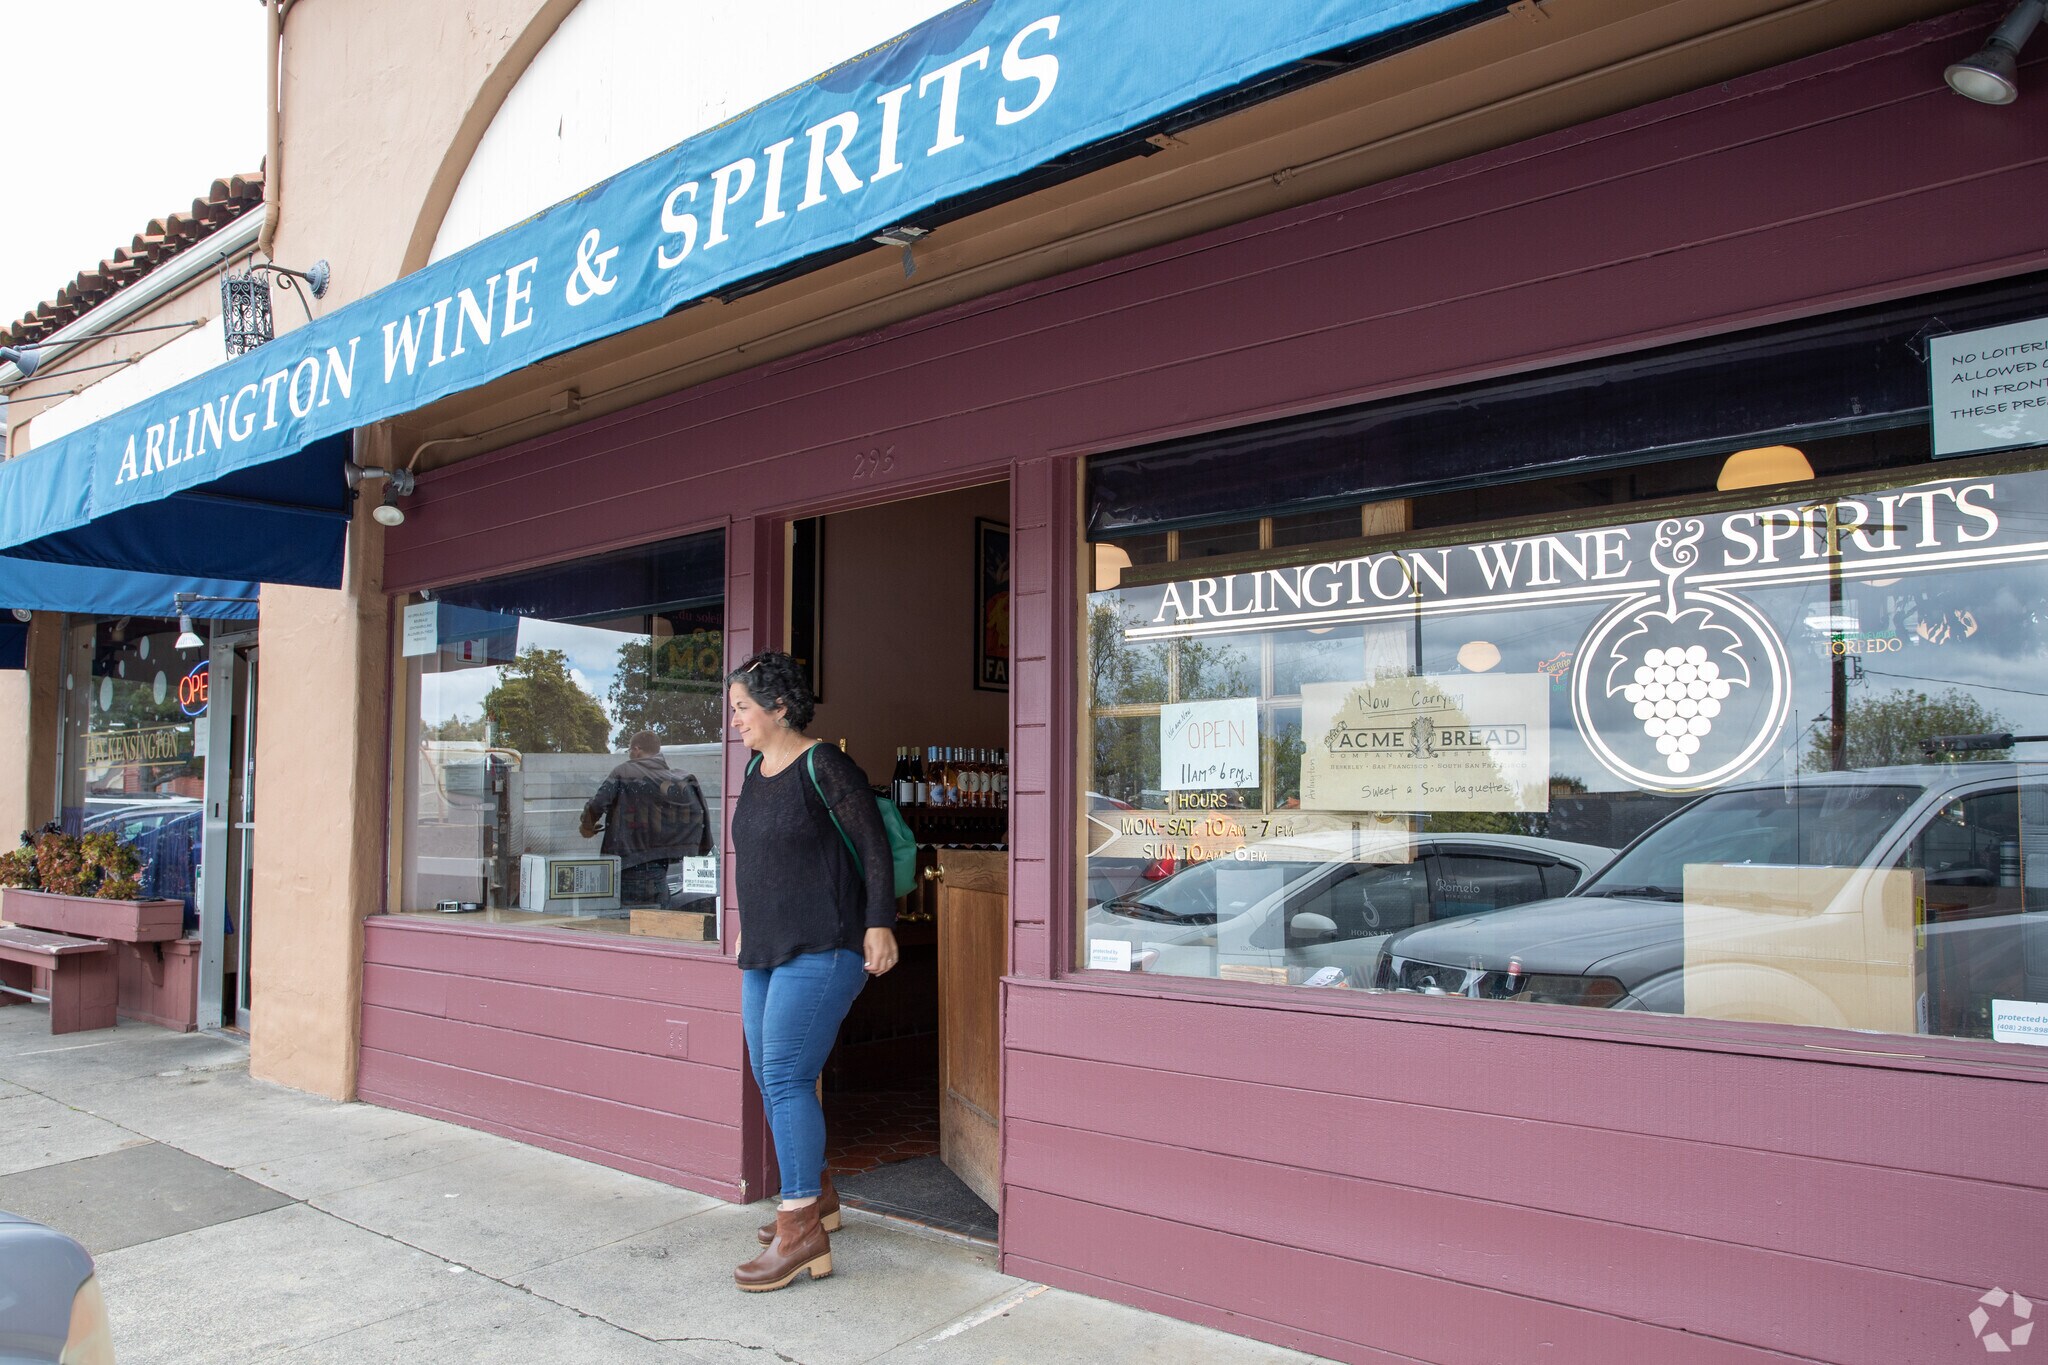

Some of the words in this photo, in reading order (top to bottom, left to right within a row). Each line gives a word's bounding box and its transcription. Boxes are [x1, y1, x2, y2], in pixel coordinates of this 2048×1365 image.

[115, 336, 360, 486] ARLINGTON
[382, 256, 539, 384] WINE
[565, 228, 620, 307] &
[657, 14, 1061, 270] SPIRITS
[1952, 353, 1976, 366] NO
[1951, 362, 2037, 384] ALLOWED
[1971, 387, 1988, 399] IN
[1950, 402, 2007, 420] THESE
[2011, 396, 2048, 411] PRE
[1153, 548, 1451, 623] ARLINGTON
[1469, 527, 1632, 590] WINE
[1650, 518, 1705, 577] &
[1723, 483, 1999, 567] SPIRITS
[1822, 638, 1903, 656] TORPEDO
[1358, 690, 1390, 711] Now
[1411, 690, 1464, 711] Carrying
[1188, 720, 1245, 749] OPEN
[1339, 732, 1405, 749] ACME
[1441, 729, 1521, 746] BREAD
[108, 731, 180, 761] KENSINGTON
[1220, 762, 1226, 780] 6
[1229, 767, 1245, 780] PM
[1361, 784, 1398, 800] Sweet
[1421, 781, 1446, 796] Sour
[1178, 793, 1228, 810] HOURS
[697, 869, 715, 879] SMOKING
[1435, 877, 1481, 894] Romelo
[1350, 929, 1378, 937] HOOKS
[1997, 1014, 2041, 1024] protected
